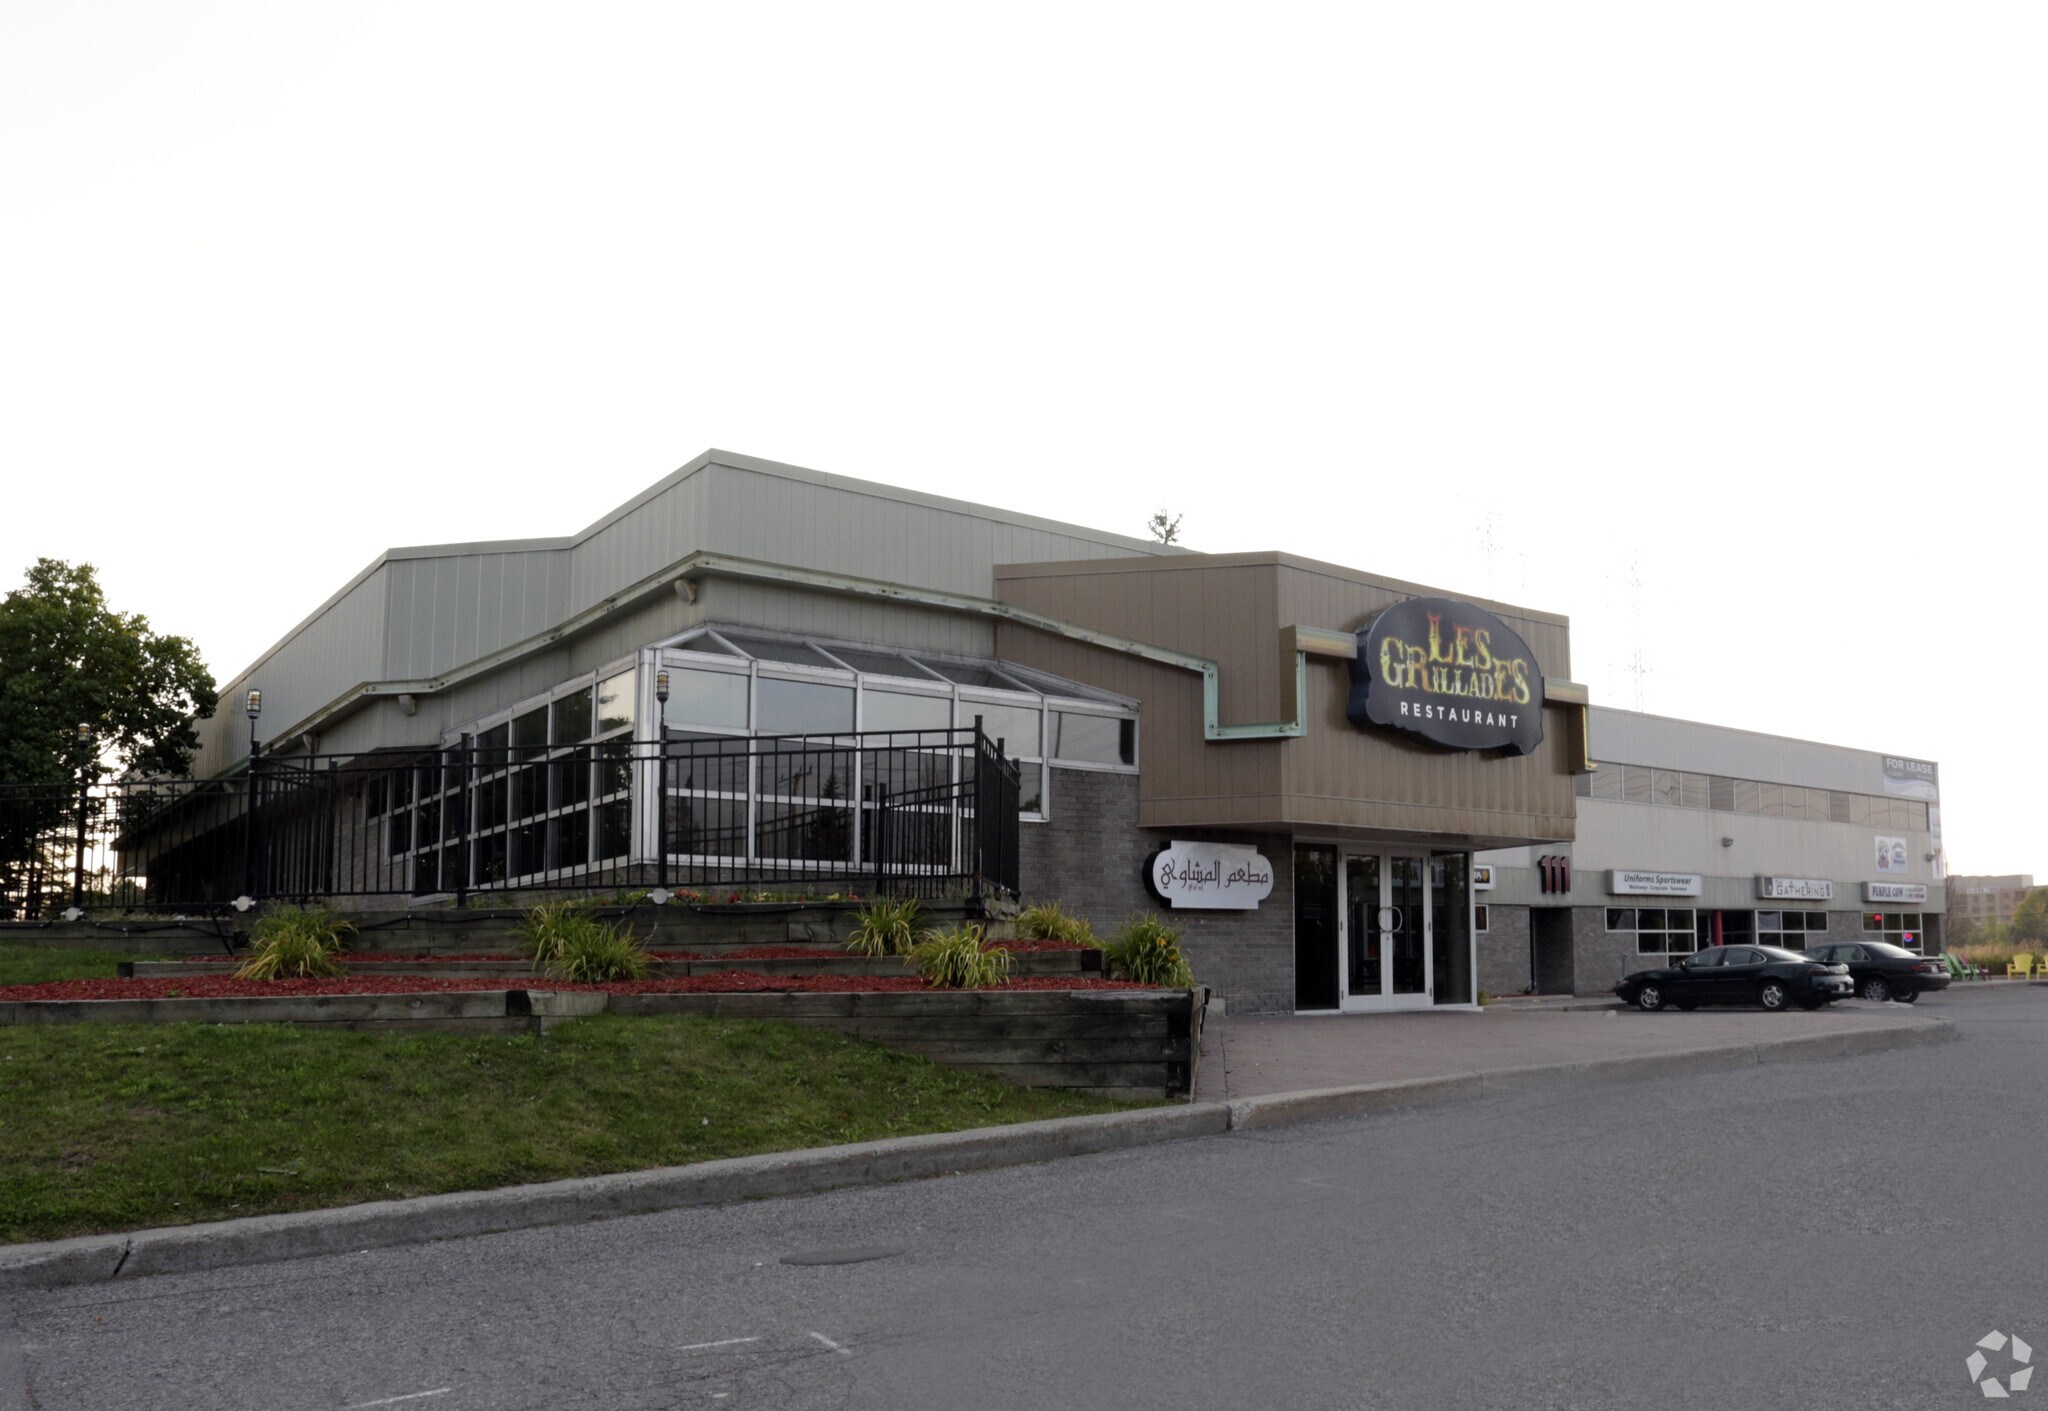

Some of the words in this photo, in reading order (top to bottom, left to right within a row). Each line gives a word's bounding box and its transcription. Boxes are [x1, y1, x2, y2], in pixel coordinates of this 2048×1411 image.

[1427, 612, 1491, 670] LES
[1380, 636, 1531, 705] GRILLADES
[1400, 700, 1518, 728] RESTAURANT
[1886, 757, 1904, 770] FOR
[1906, 761, 1934, 775] LEASE
[1224, 860, 1269, 888] مطعم
[1538, 855, 1571, 894] 111
[1623, 873, 1655, 884] Uniforms
[1655, 875, 1692, 886] Sportswear
[1776, 881, 1826, 897] GATHERING
